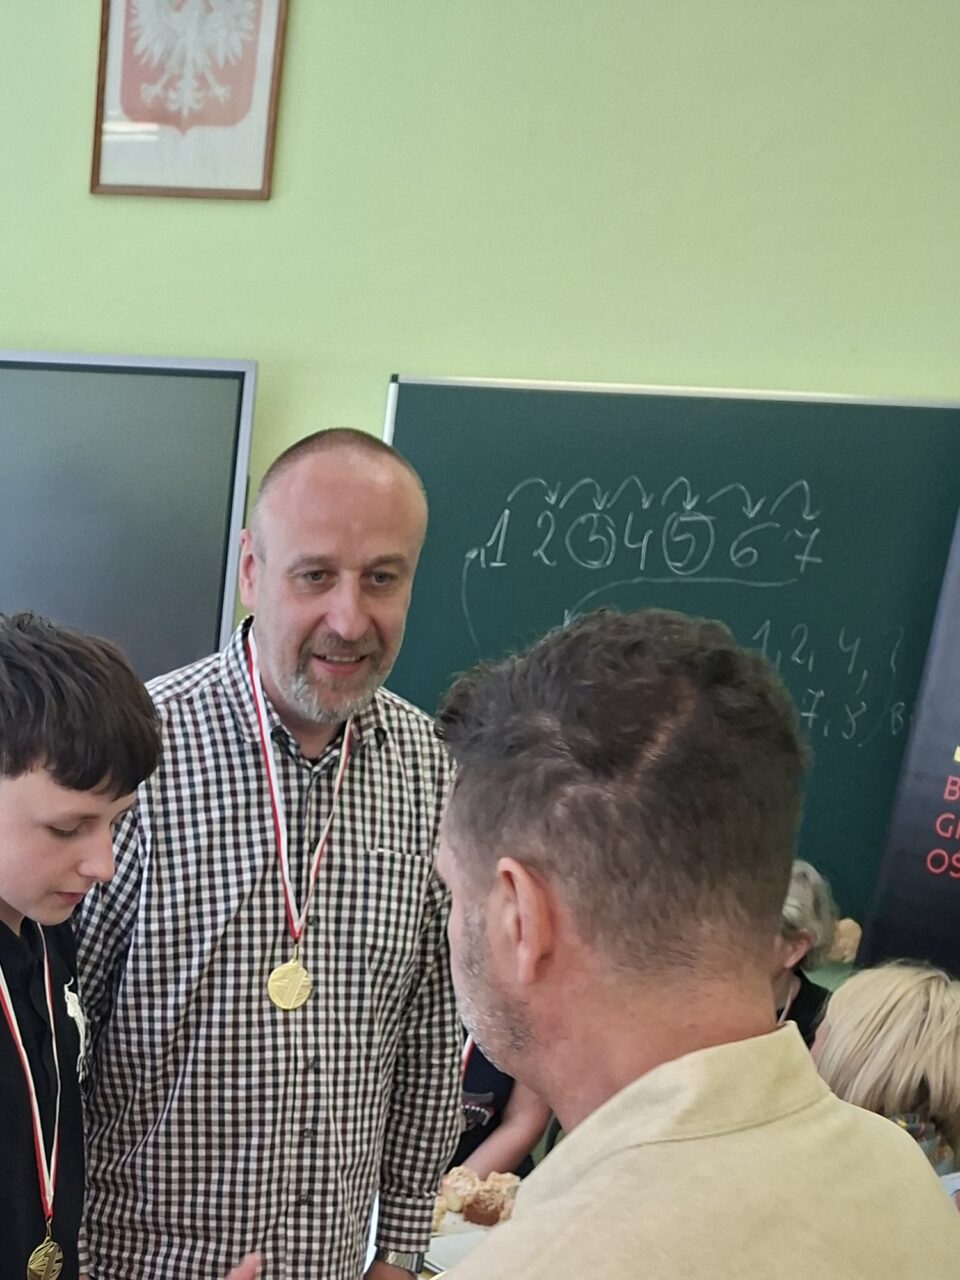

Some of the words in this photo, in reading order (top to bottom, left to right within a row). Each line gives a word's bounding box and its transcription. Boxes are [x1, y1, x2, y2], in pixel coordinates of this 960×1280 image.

[486, 508, 507, 567] 1
[532, 510, 557, 566] 2
[624, 512, 654, 570] 4
[730, 522, 781, 568] 6
[787, 528, 823, 573] 7
